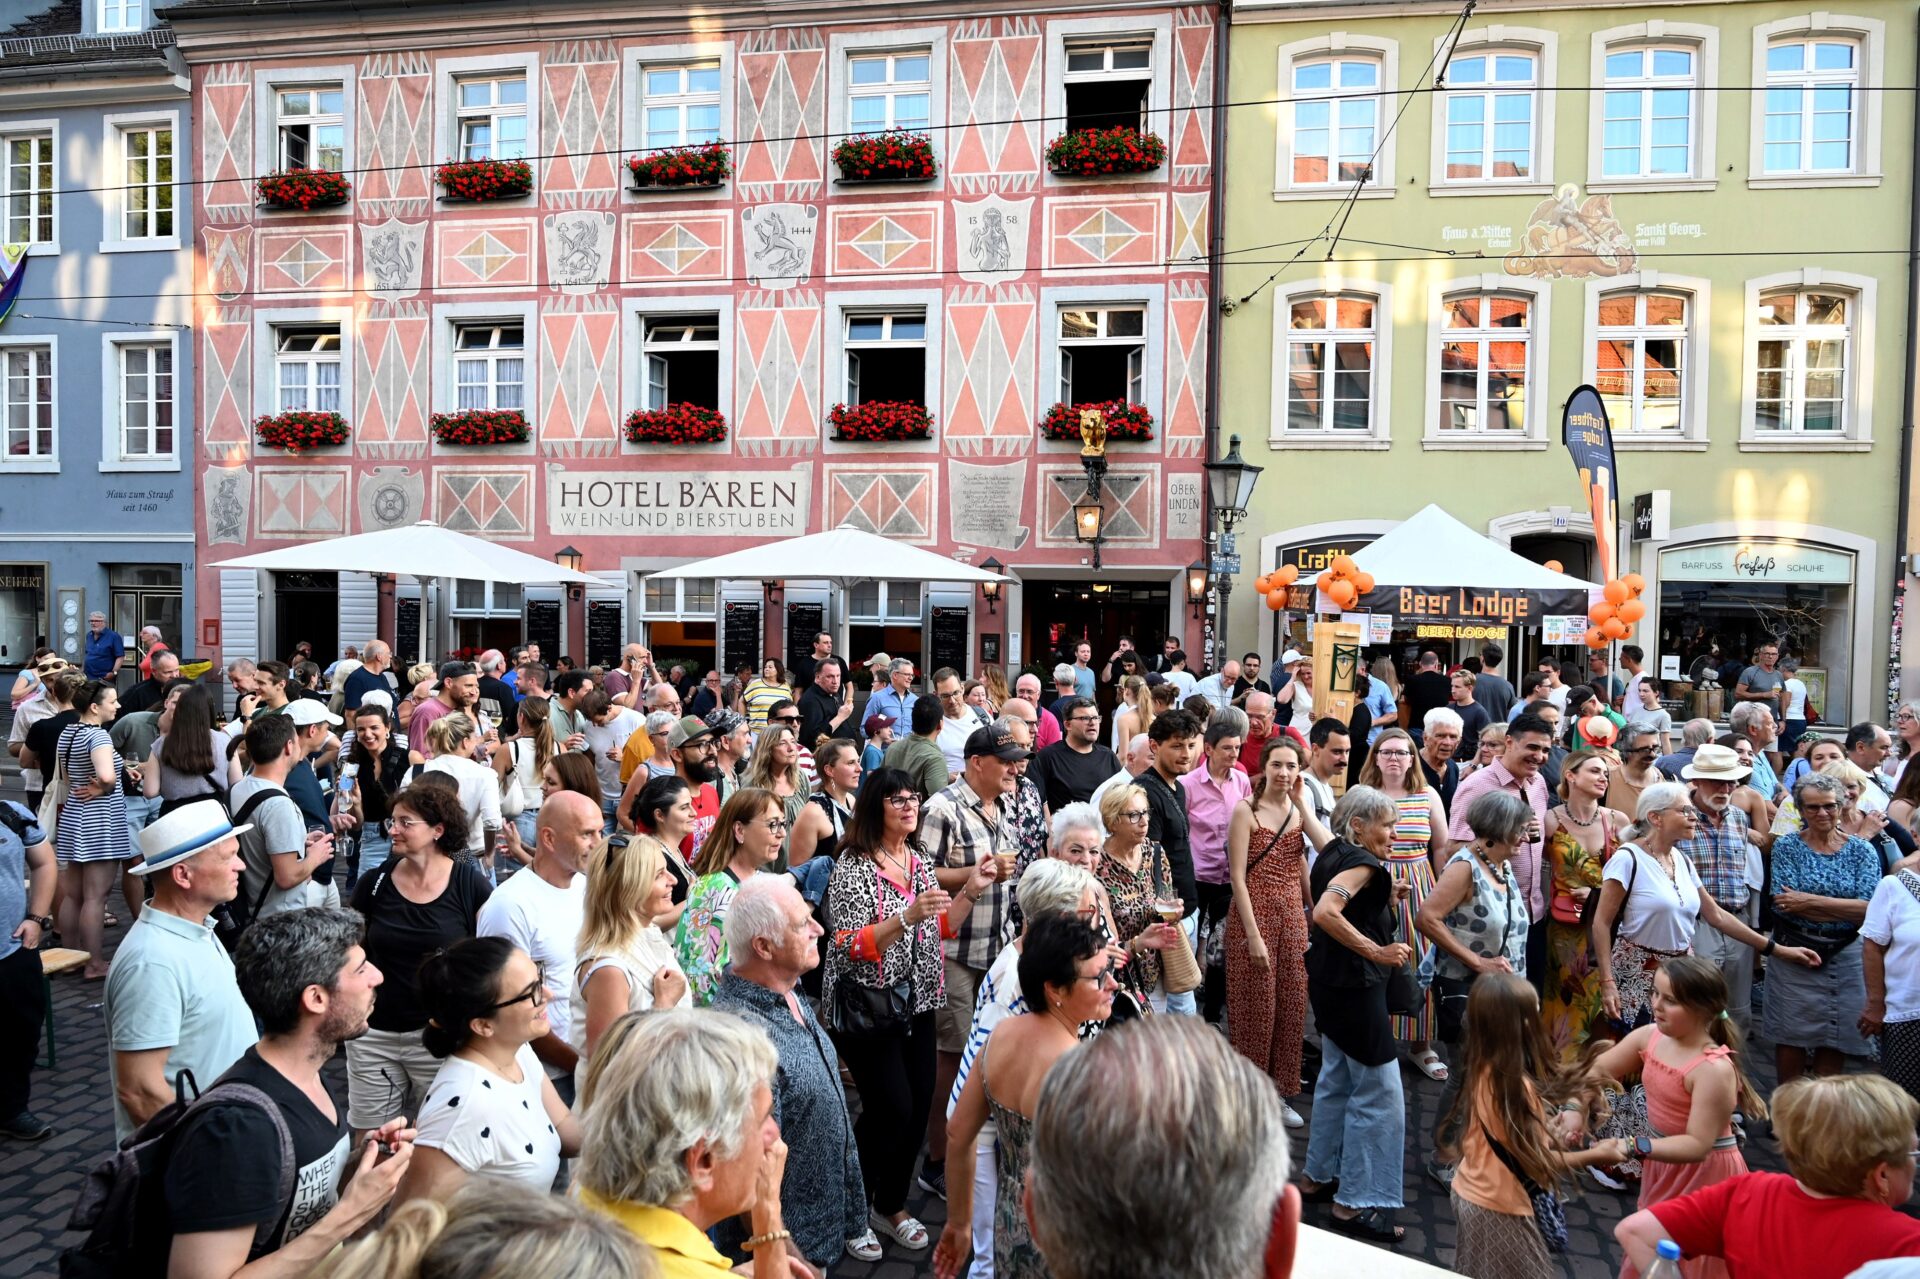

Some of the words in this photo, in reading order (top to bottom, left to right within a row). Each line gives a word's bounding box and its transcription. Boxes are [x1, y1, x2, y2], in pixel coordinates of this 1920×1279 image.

[968, 216, 977, 225] 13
[1006, 215, 1018, 225] 58
[791, 226, 812, 235] 1444
[1635, 223, 1667, 238] Sankt
[1669, 222, 1701, 239] Georg
[105, 489, 127, 499] Haus
[128, 491, 146, 499] zum
[146, 488, 175, 502] Strauß
[561, 481, 670, 508] HOTEL
[678, 481, 797, 508] BÄREN
[121, 504, 136, 512] seit
[138, 503, 158, 512] 1460
[1169, 498, 1200, 510] LINDEN
[676, 512, 795, 528] BIERSTUBEN
[1176, 512, 1188, 525] 12
[1555, 517, 1566, 526] 10
[1298, 548, 1346, 569] Craf
[184, 562, 194, 571] 14
[1681, 561, 1723, 570] BARFUSS
[1786, 564, 1825, 573] SCHUHE
[0, 576, 42, 588] SEIFERT
[1400, 587, 1451, 614] Beer
[1459, 589, 1528, 624] Lodge
[1416, 625, 1453, 638] BEER
[1455, 626, 1507, 640] LODGE
[299, 1177, 329, 1201] THE
[295, 1193, 327, 1215] SUN
